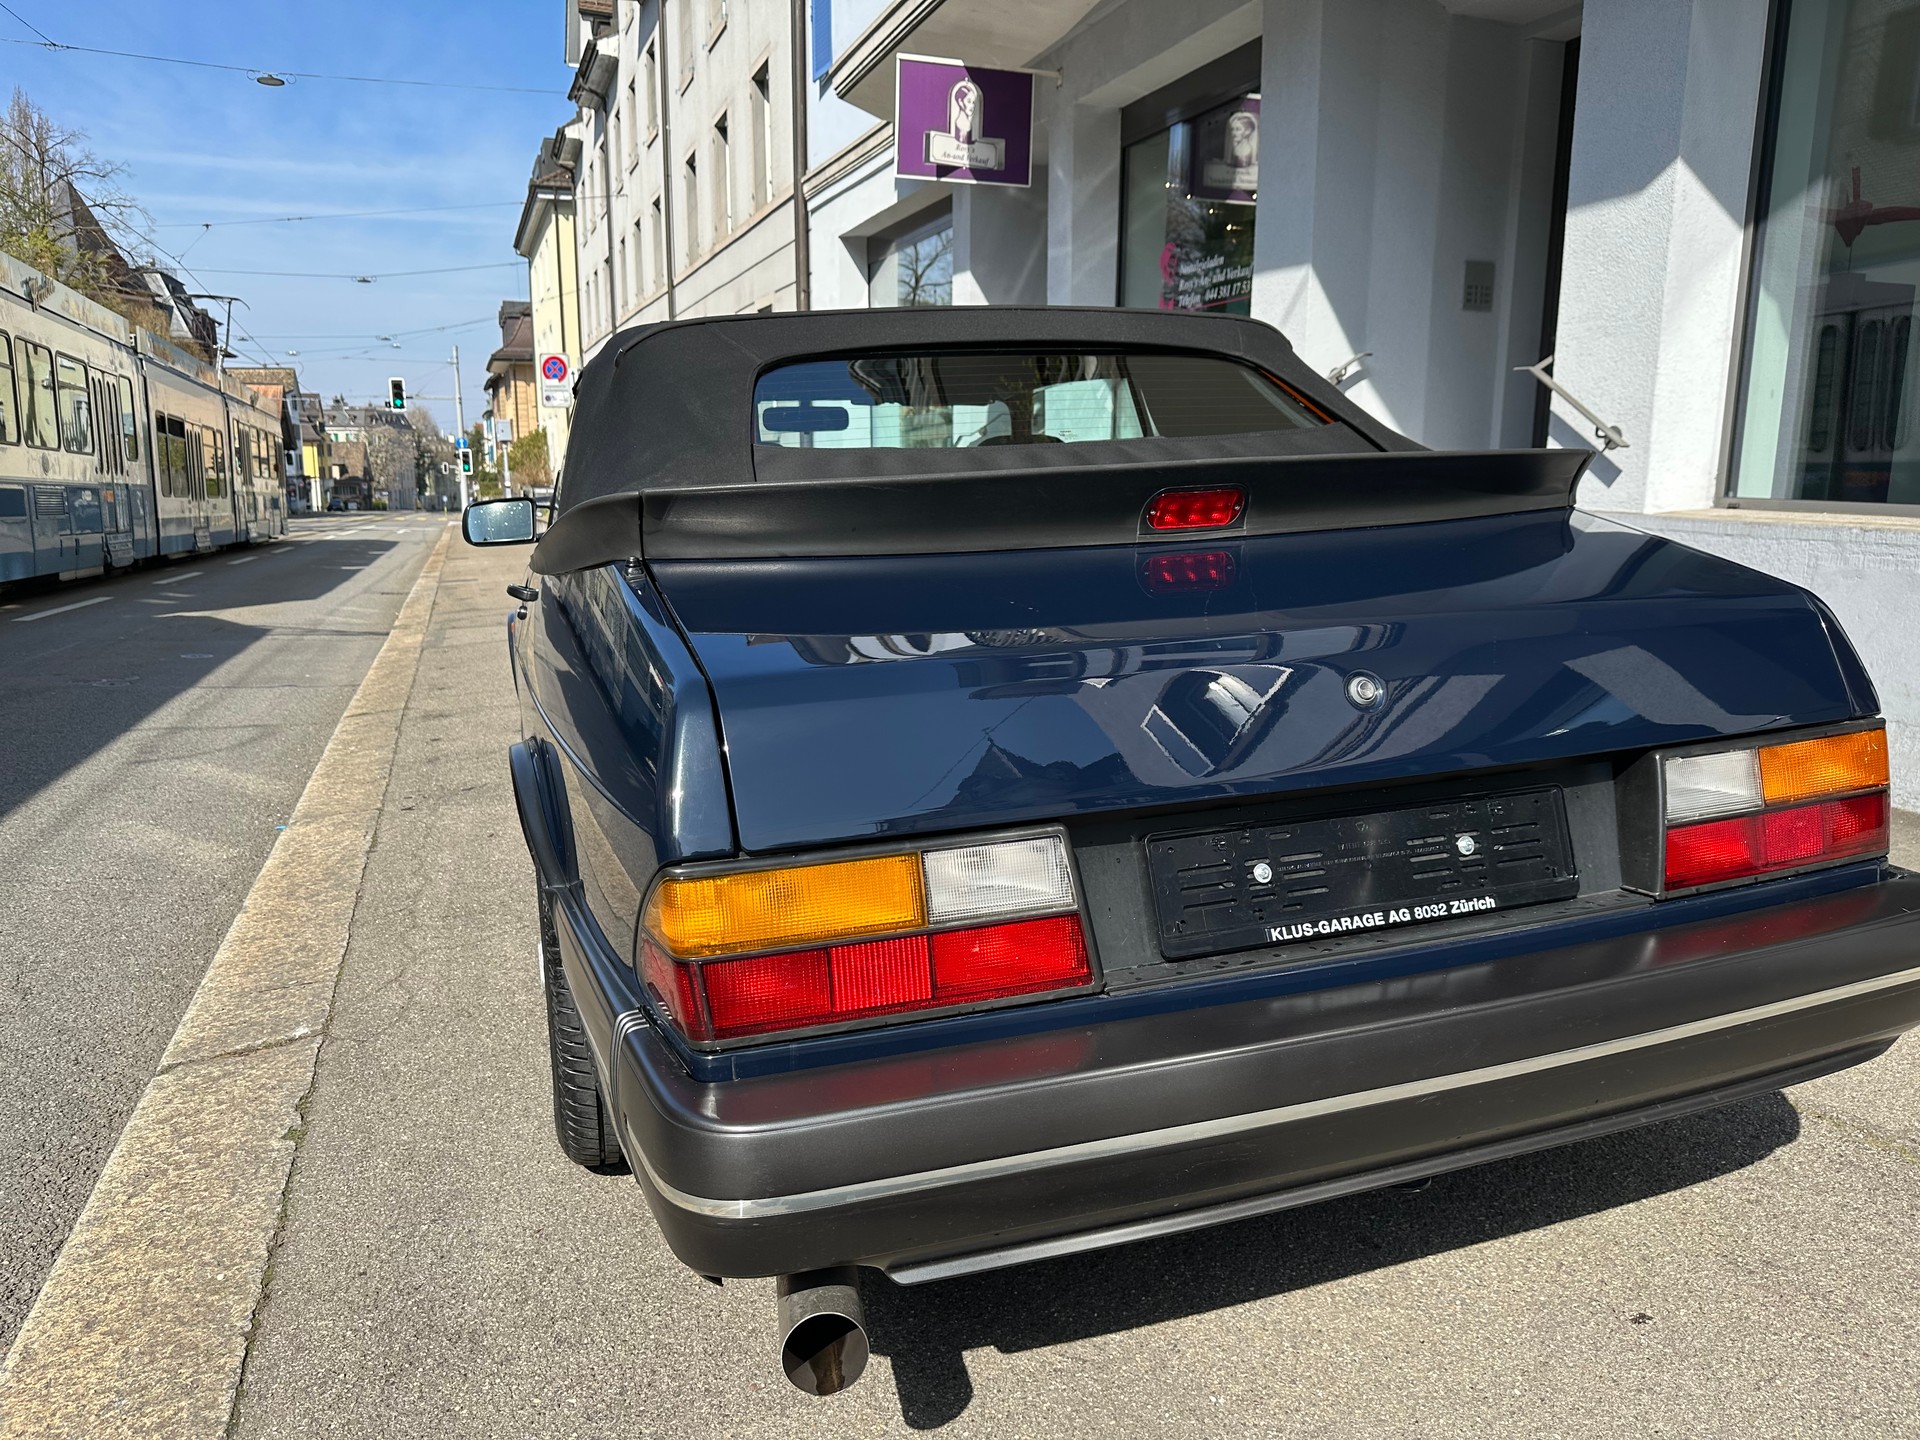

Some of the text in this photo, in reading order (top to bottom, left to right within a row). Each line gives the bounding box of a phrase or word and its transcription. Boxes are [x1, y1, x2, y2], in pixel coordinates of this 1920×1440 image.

[1212, 270, 1226, 282] und
[1227, 264, 1254, 279] Verkauf
[1205, 289, 1218, 301] 044
[1232, 282, 1241, 295] 17
[1241, 280, 1250, 293] 53
[1271, 896, 1496, 942] KLUS-GARAGE AG 8032 Zürich
